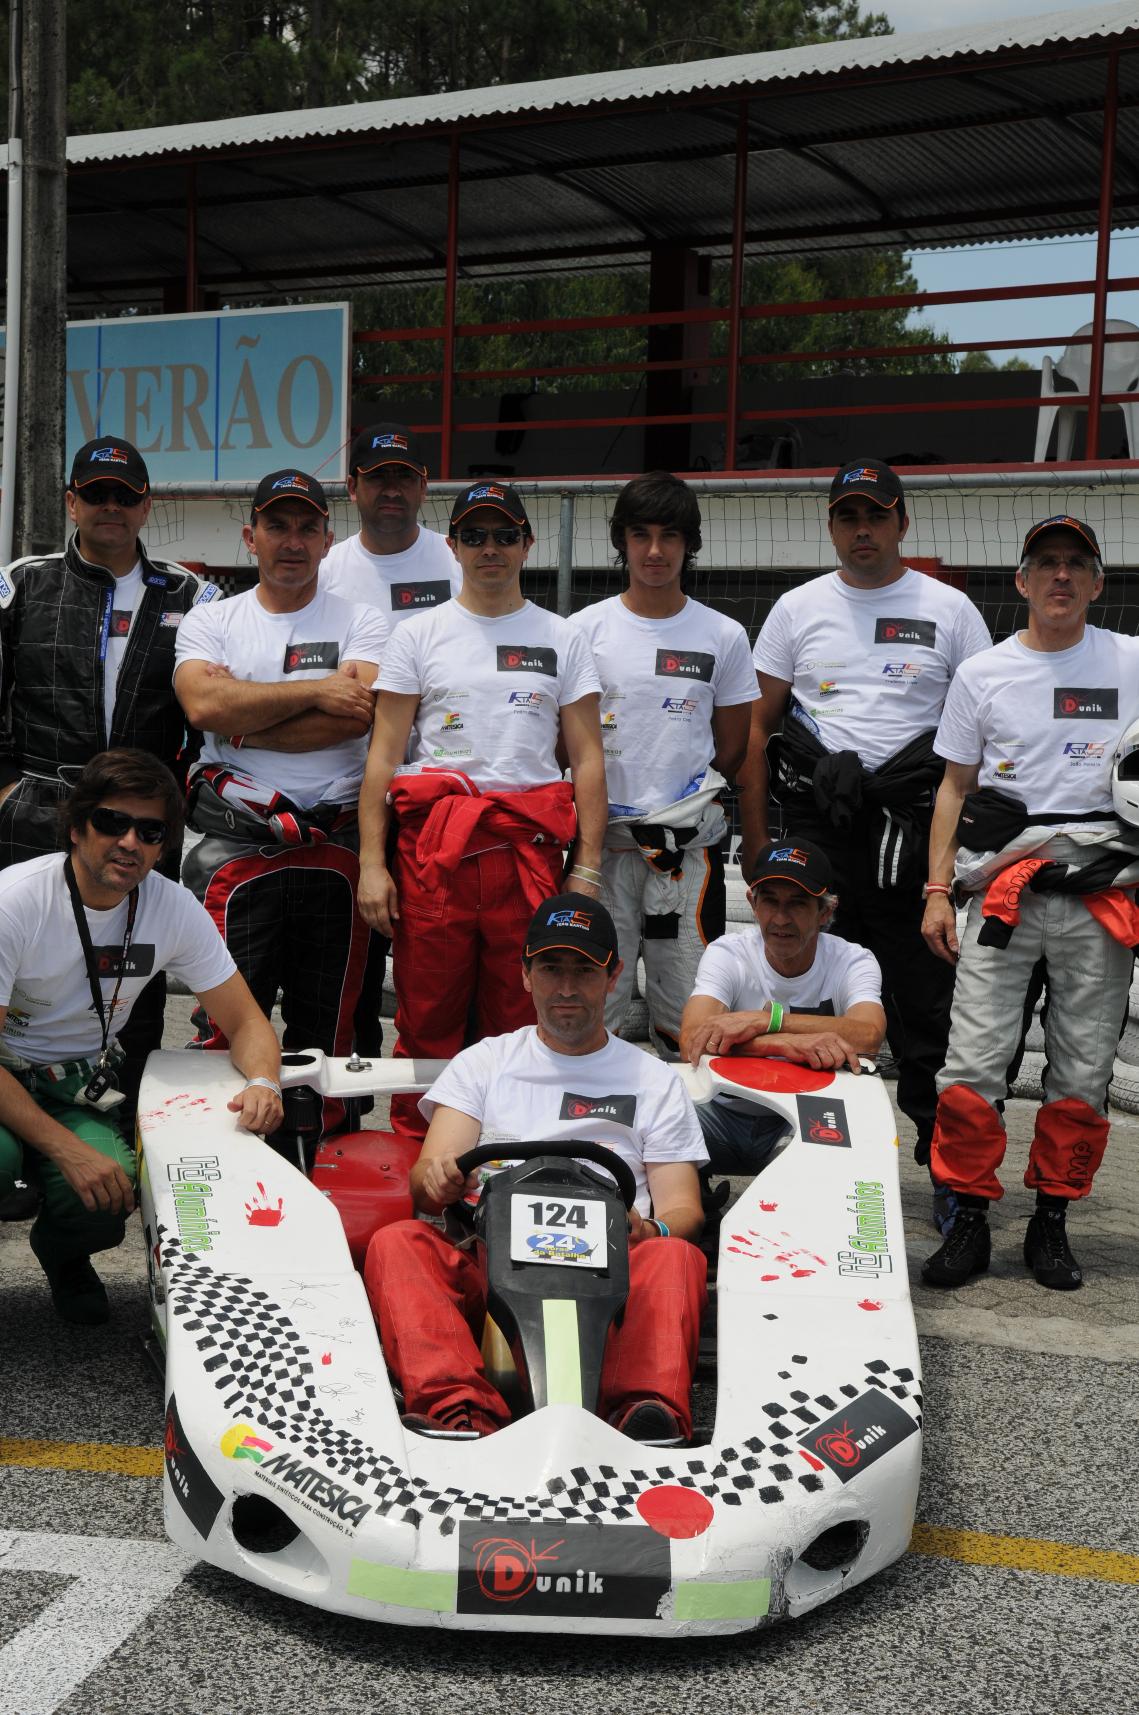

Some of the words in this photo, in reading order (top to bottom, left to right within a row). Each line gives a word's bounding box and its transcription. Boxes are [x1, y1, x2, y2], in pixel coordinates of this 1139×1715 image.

[66, 334, 334, 451] VERÃO
[401, 591, 436, 604] Dunik
[885, 627, 921, 640] Dunik
[289, 653, 323, 667] Dunik
[508, 655, 543, 668] Dunik
[666, 659, 701, 674] Dunik
[1065, 700, 1103, 713] Dunik
[1003, 859, 1044, 911] OMP
[574, 1103, 617, 1116] Dunik
[819, 1111, 838, 1137] Dunik
[172, 1182, 221, 1252] Alumínios
[528, 1202, 588, 1229] 124
[846, 1180, 889, 1253] Alumínios
[536, 1234, 576, 1251] 24
[830, 1424, 887, 1461] Dunik
[254, 1470, 278, 1489] MATERIAIS
[276, 1484, 301, 1505] SINTÉTICOS
[300, 1500, 313, 1513] PARA
[312, 1508, 345, 1533] CONSTRUÇÃO,
[260, 1452, 373, 1528] MATESICA
[493, 1555, 604, 1594] Dunik
